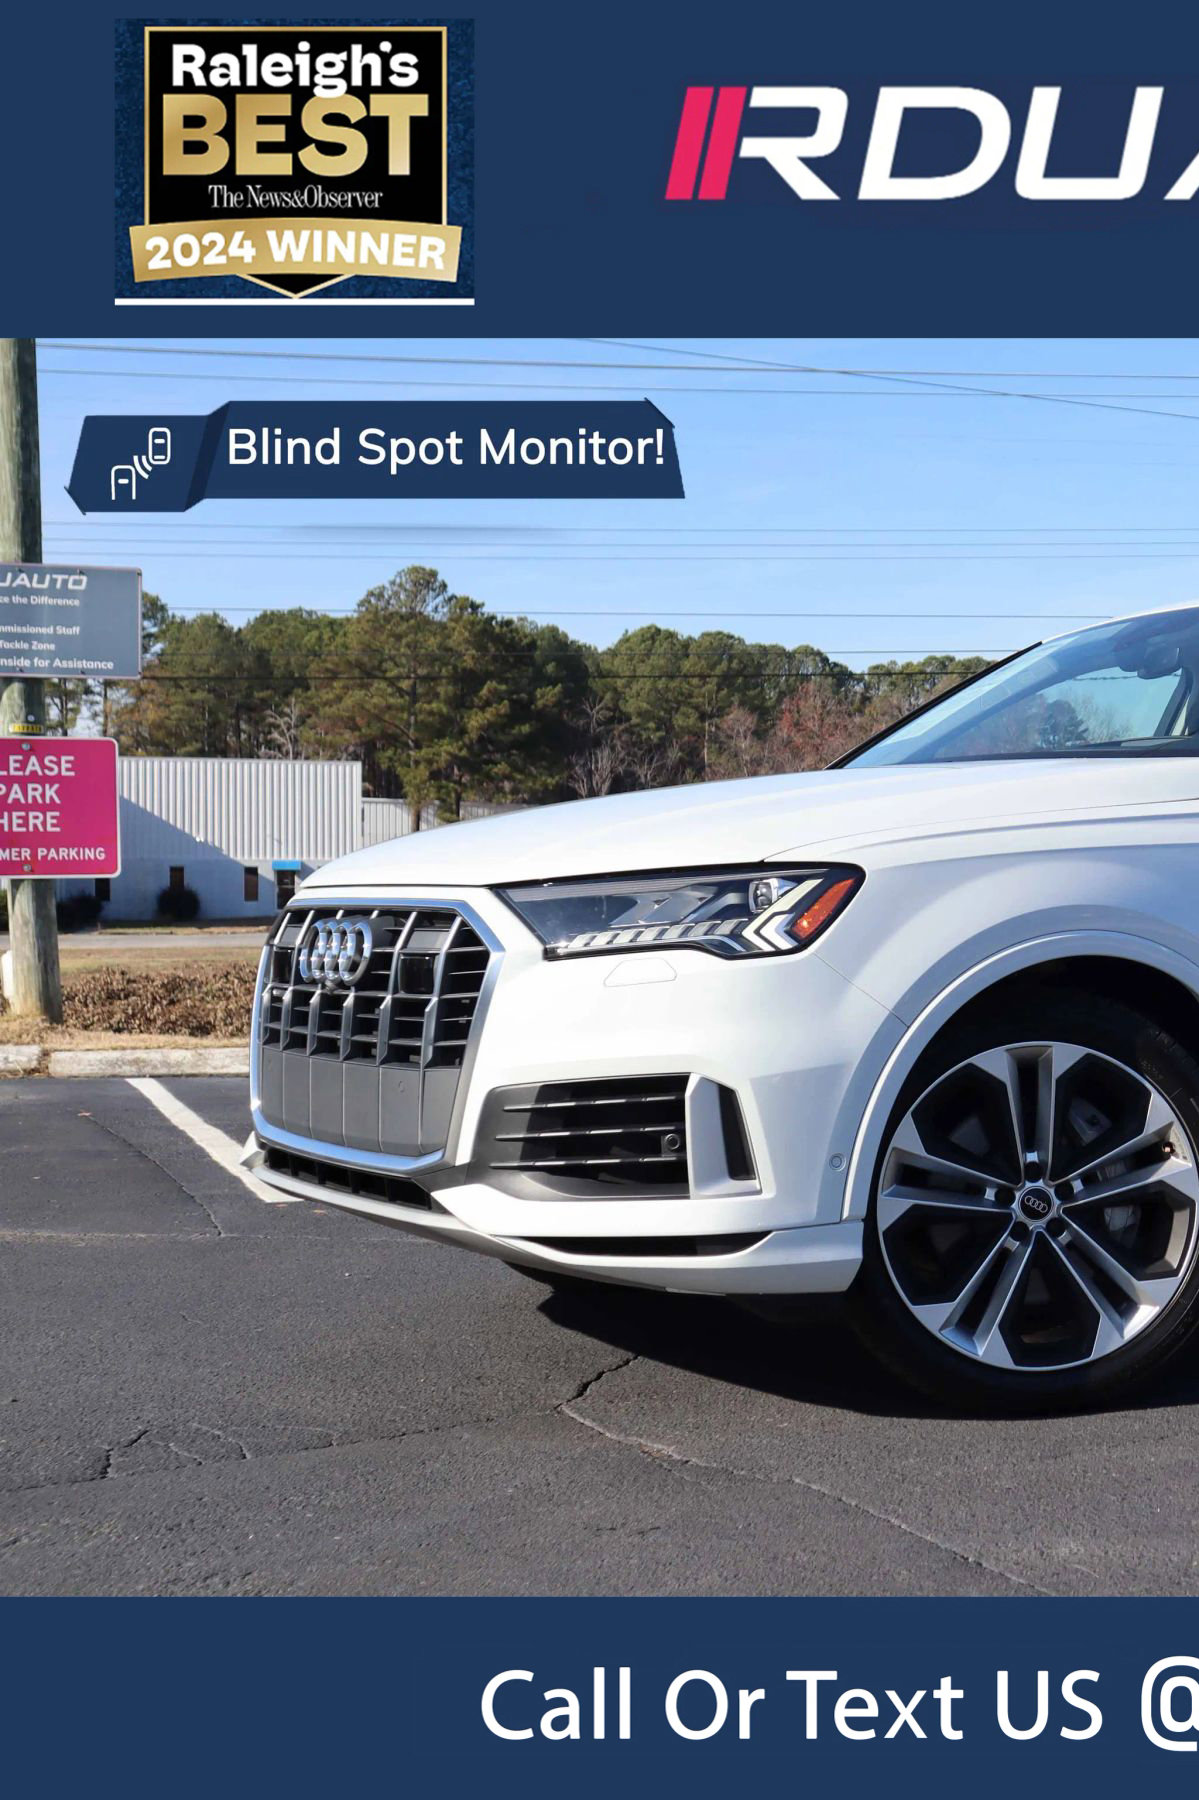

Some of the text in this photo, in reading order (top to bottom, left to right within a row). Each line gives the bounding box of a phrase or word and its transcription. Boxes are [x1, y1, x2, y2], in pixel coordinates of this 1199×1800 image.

[12, 594, 28, 605] the
[30, 595, 80, 607] Difference
[56, 625, 80, 635] Staff
[31, 640, 55, 651] Zone
[33, 657, 50, 668] for
[52, 657, 115, 670] Assistance
[38, 847, 106, 861] PARKING
